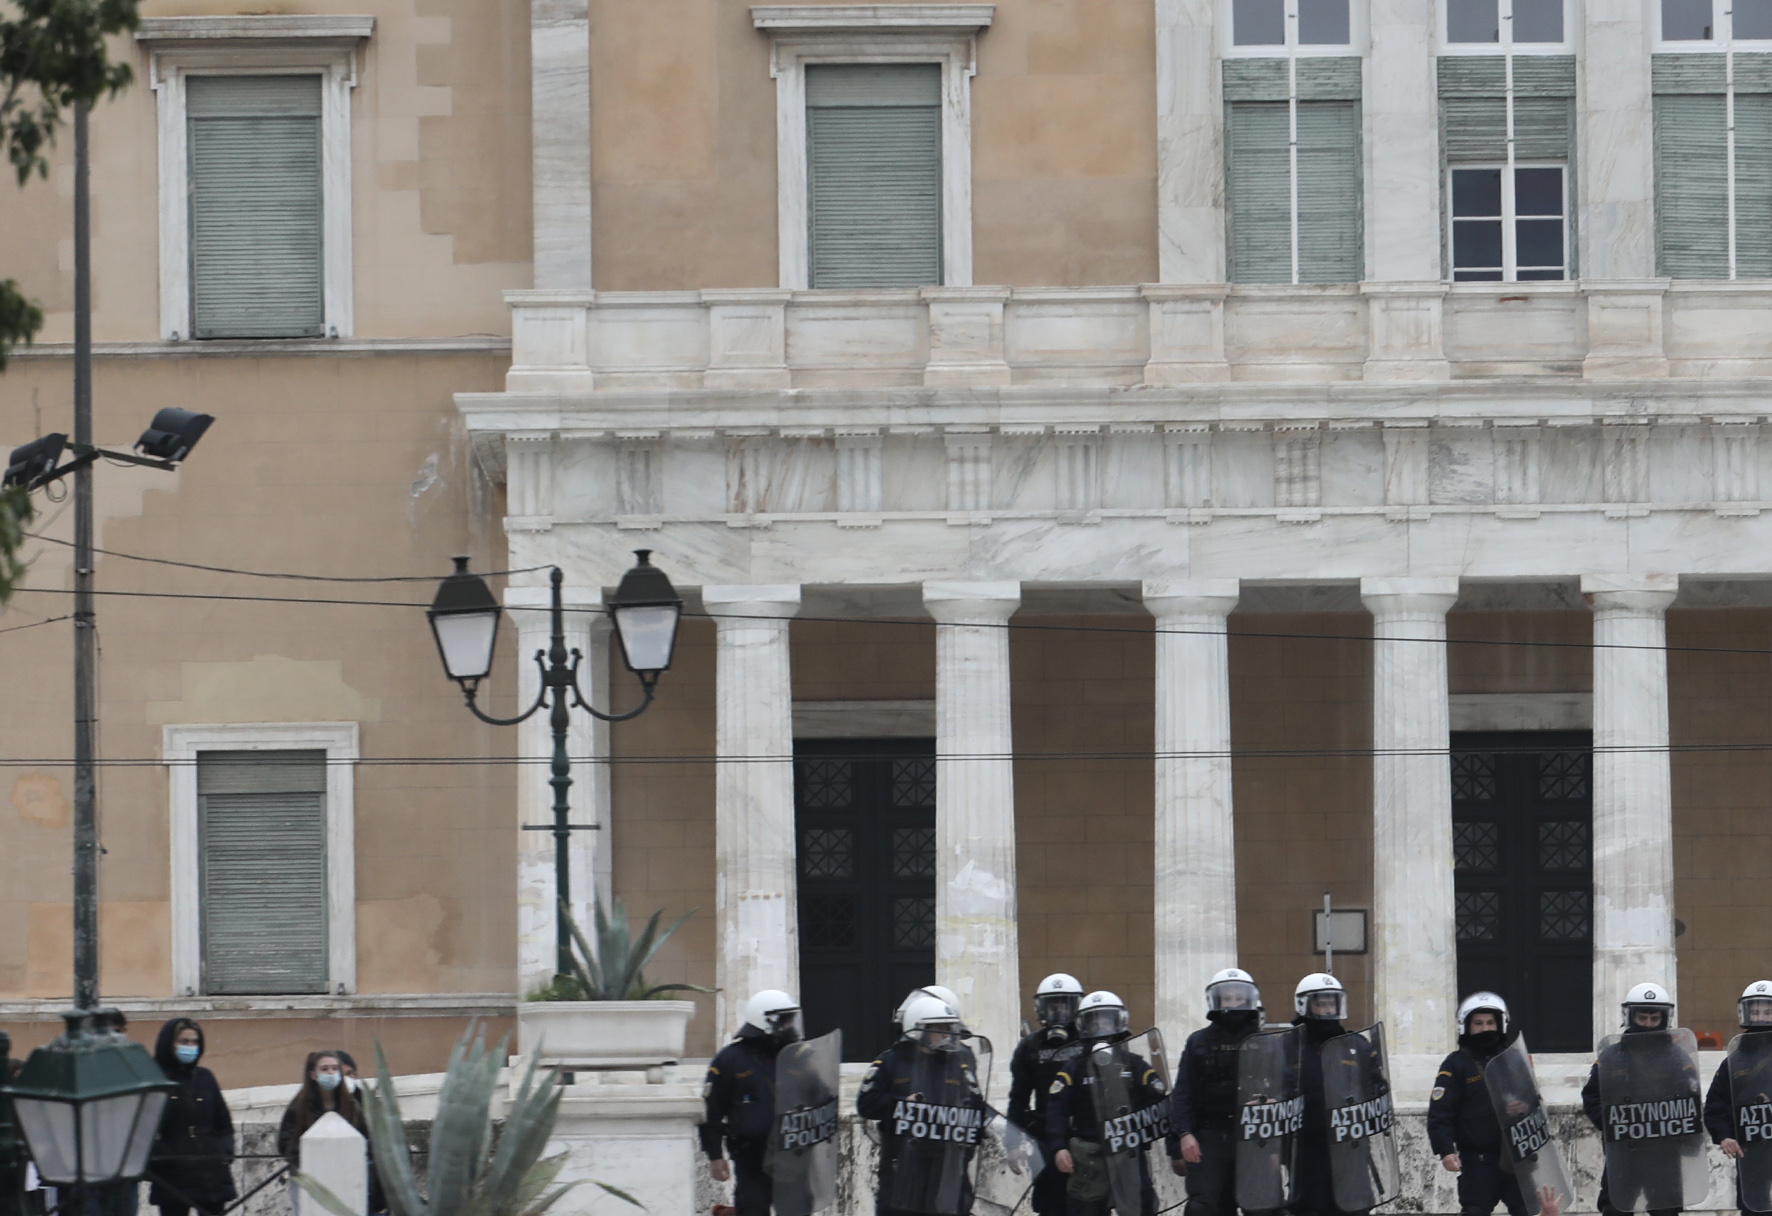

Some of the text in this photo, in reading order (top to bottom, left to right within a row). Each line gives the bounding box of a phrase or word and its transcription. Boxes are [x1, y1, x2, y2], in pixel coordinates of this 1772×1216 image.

[892, 1100, 983, 1128] ΑΣΤΥΝΟΜΙΑ
[1609, 1097, 1697, 1124] ΑΣΤΥΝΟΜΙΑ
[895, 1120, 979, 1143] POLICE
[1110, 1118, 1170, 1153] POLIC
[1244, 1113, 1304, 1140] POLICE
[1336, 1110, 1393, 1142] POLICE
[1614, 1117, 1696, 1140] POLICE
